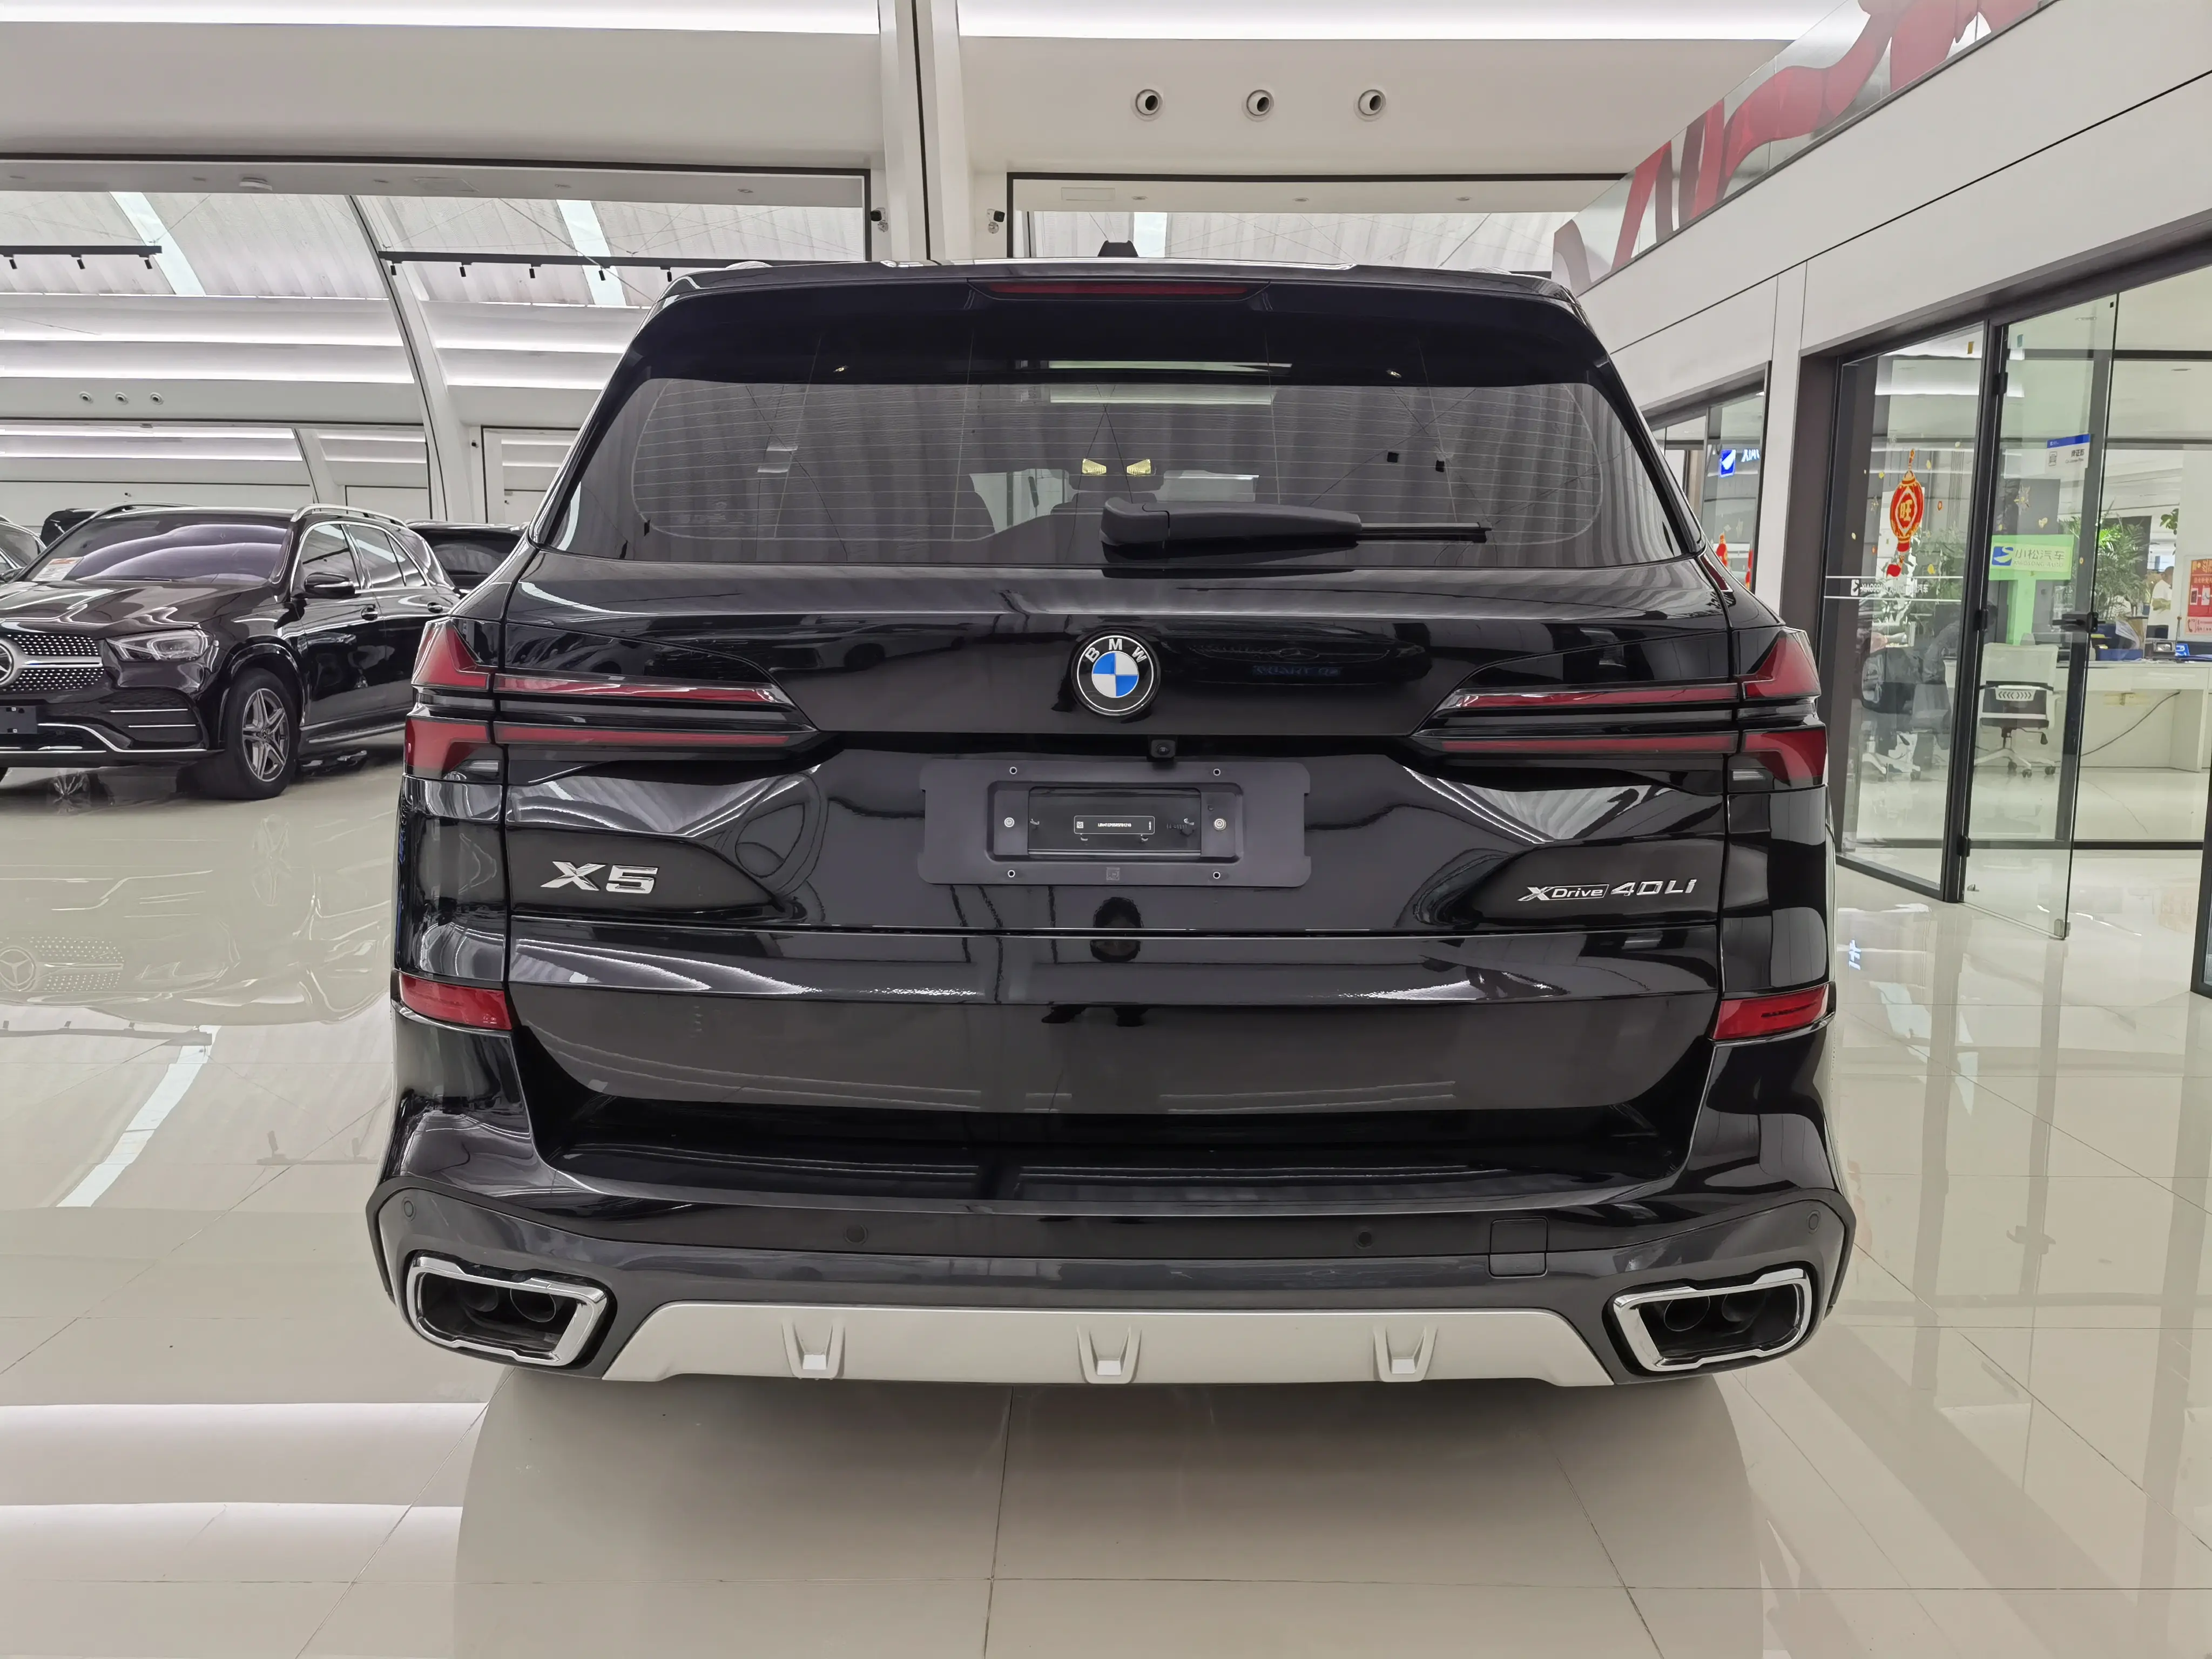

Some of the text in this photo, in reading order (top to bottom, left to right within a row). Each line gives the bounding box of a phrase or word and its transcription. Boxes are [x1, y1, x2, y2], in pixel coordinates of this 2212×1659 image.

[1899, 499, 1913, 522] 旺
[2015, 548, 2065, 561] 小松汽车
[1085, 638, 1147, 663] BMW
[541, 861, 658, 894] X5
